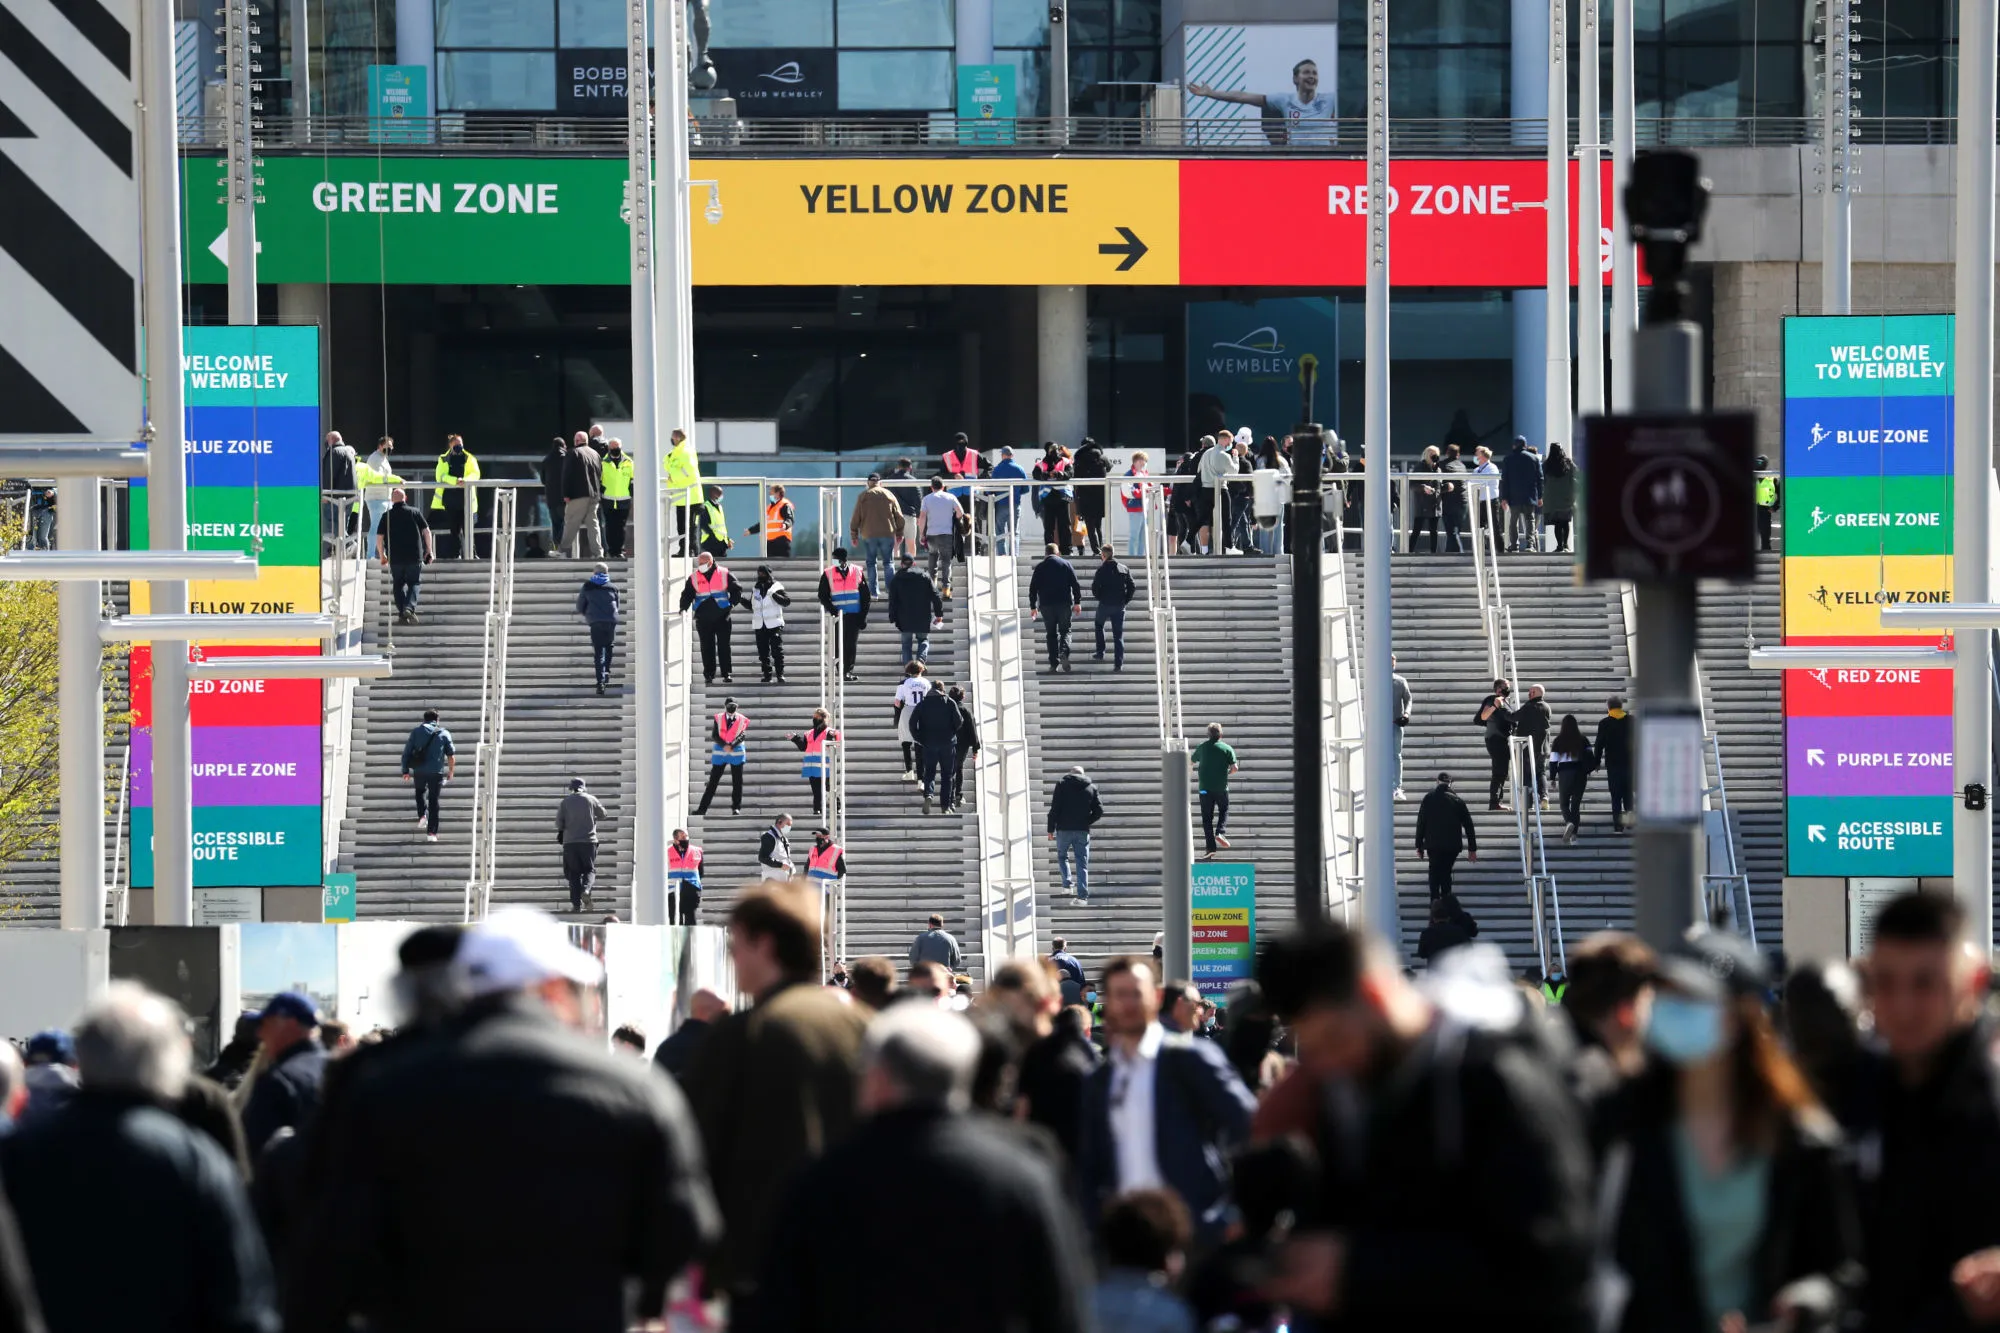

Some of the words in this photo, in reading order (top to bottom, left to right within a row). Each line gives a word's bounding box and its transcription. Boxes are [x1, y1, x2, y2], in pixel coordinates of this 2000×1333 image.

[573, 67, 628, 80] BOBB
[312, 182, 441, 213] GREEN
[453, 183, 559, 214] ZONE
[799, 184, 954, 214] YELLOW
[965, 184, 1068, 213] ZONE
[1410, 185, 1511, 215] ZONE
[1831, 344, 1930, 362] WELCOME
[1206, 358, 1294, 373] WEMBLEY
[1815, 364, 1842, 379] TO
[1847, 362, 1946, 379] WEMBLEY
[191, 372, 288, 389] WEMBLEY
[1836, 430, 1879, 444] BLUE
[1883, 430, 1929, 443] ZONE
[227, 440, 273, 454] ZONE
[1834, 514, 1890, 527] GREEN
[1895, 512, 1940, 526] ZONE
[239, 523, 284, 537] ZONE
[1834, 591, 1900, 604] YELLOW
[1906, 591, 1950, 604] ZONE
[190, 602, 245, 614] ELLOW
[250, 602, 294, 614] ZONE
[1838, 670, 1872, 684] RED
[1875, 670, 1921, 684] ZONE
[220, 680, 265, 694] ZONE
[912, 690, 924, 704] 11
[1837, 754, 1903, 767] PURPLE
[1908, 752, 1953, 766] ZONE
[192, 764, 247, 776] URPLE
[251, 762, 297, 776] ZONE
[1838, 822, 1942, 836] ACCESSIBLE
[193, 832, 285, 846] CCESSIBLE
[1838, 836, 1895, 850] ROUTE
[193, 846, 238, 860] OUTE
[1233, 876, 1248, 886] TO
[335, 886, 350, 896] TO
[1192, 886, 1240, 896] EMBLEY
